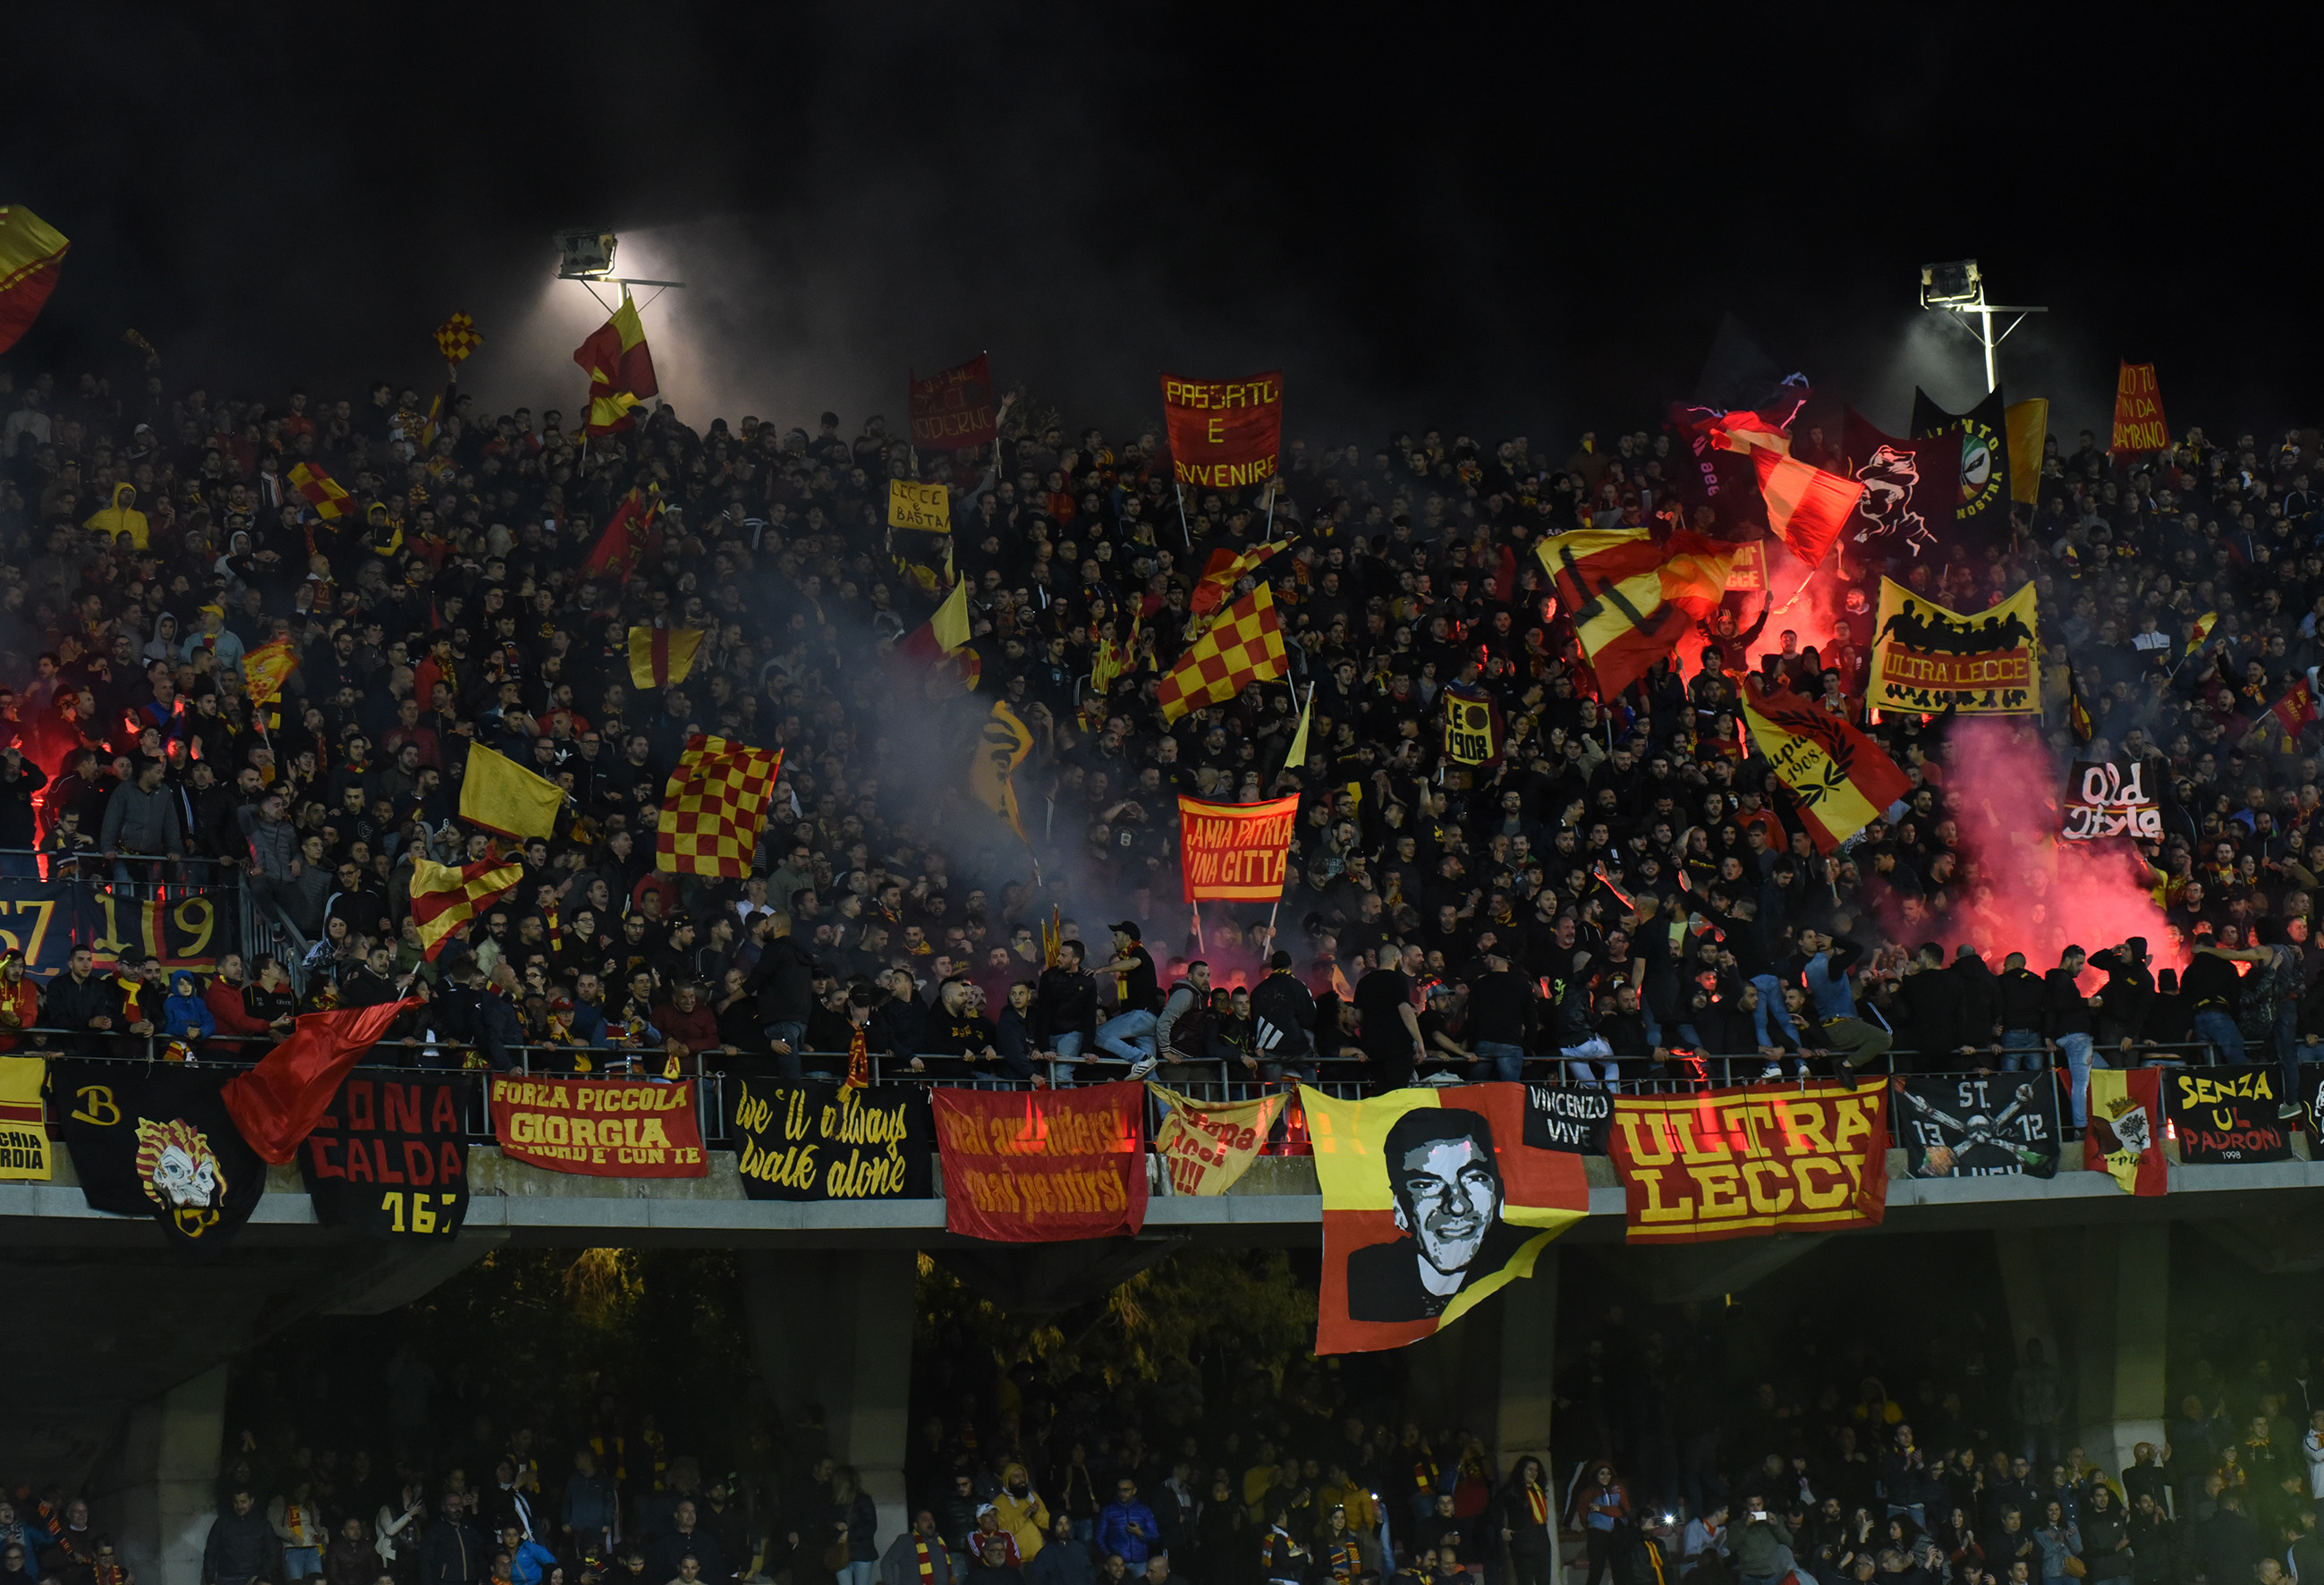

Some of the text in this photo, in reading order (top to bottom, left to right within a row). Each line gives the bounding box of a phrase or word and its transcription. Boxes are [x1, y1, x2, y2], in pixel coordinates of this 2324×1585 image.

[1166, 379, 1279, 411] PASSATO
[2136, 397, 2158, 419] DA
[1209, 418, 1225, 444] E
[2113, 420, 2166, 450] BAMBINO
[1175, 453, 1277, 487] AVVENIRE
[892, 484, 941, 506] LECCE
[1956, 471, 2003, 520] NOSTRA
[1955, 657, 2029, 683] LECCE
[1448, 729, 1489, 760] 1908
[2082, 762, 2150, 806] Old
[1234, 813, 1293, 848] PATRIA
[493, 1079, 688, 1112] FORZA PICCOLA
[2177, 1071, 2274, 1110] SENZA
[510, 1112, 673, 1149] GIORGIA
[820, 1089, 908, 1162] always
[1547, 1118, 1590, 1147] VIVE
[1912, 1120, 1947, 1147] 13
[2014, 1114, 2048, 1142] 12
[2182, 1125, 2282, 1156] PADRONI
[307, 1135, 463, 1187] CALDA
[671, 1147, 702, 1165] TE
[739, 1132, 907, 1199] walk alone
[2221, 1150, 2242, 1160] 1998
[963, 1159, 1128, 1225] mai pentirsi
[381, 1191, 457, 1234] 167
